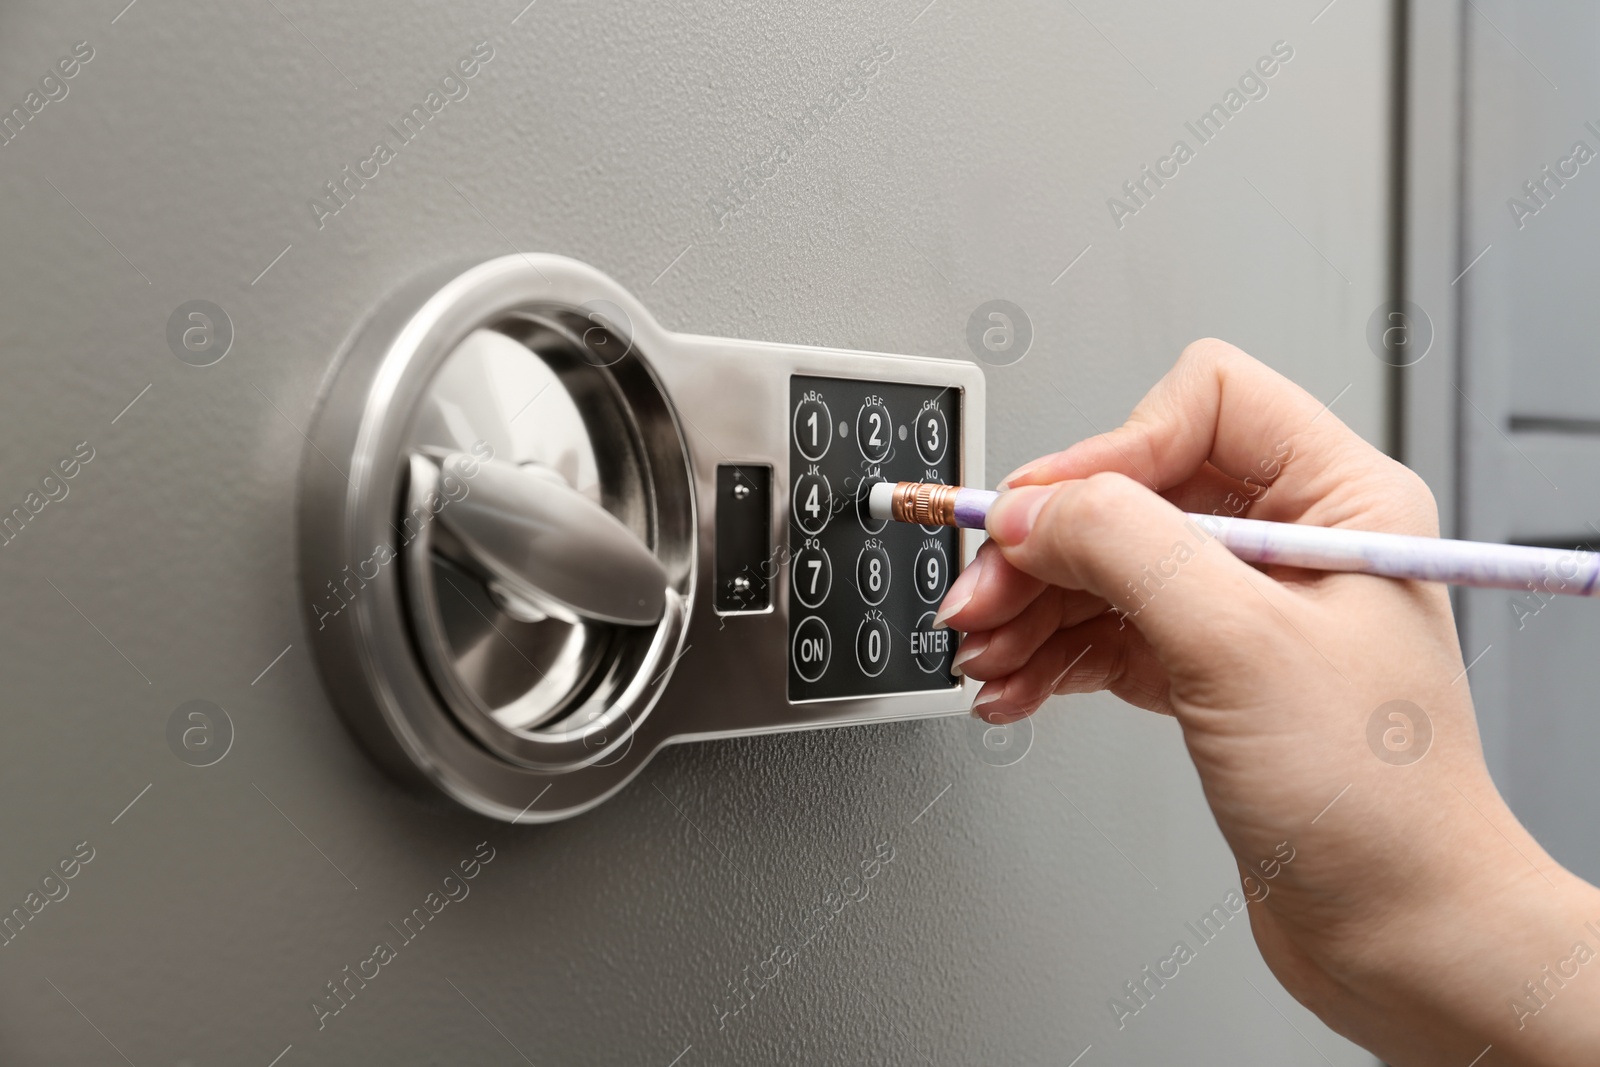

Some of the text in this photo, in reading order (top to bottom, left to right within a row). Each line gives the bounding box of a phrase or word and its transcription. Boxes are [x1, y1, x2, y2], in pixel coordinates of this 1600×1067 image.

[803, 390, 824, 404] ABC
[865, 395, 884, 407] DEF
[923, 400, 940, 412] GHI
[807, 412, 818, 439] 1
[868, 413, 882, 446] 2
[927, 418, 940, 451] 3
[806, 464, 820, 476] JK
[926, 469, 938, 480] NO
[804, 484, 820, 518] 4
[806, 539, 820, 550] PQ
[864, 540, 884, 551] RST
[922, 539, 942, 551] UVW
[808, 560, 822, 594] 7
[868, 558, 882, 592] 8
[926, 558, 939, 590] 9
[864, 610, 883, 623] XYZ
[801, 638, 824, 663] ON
[868, 630, 880, 662] 0
[910, 630, 949, 655] ENTER
